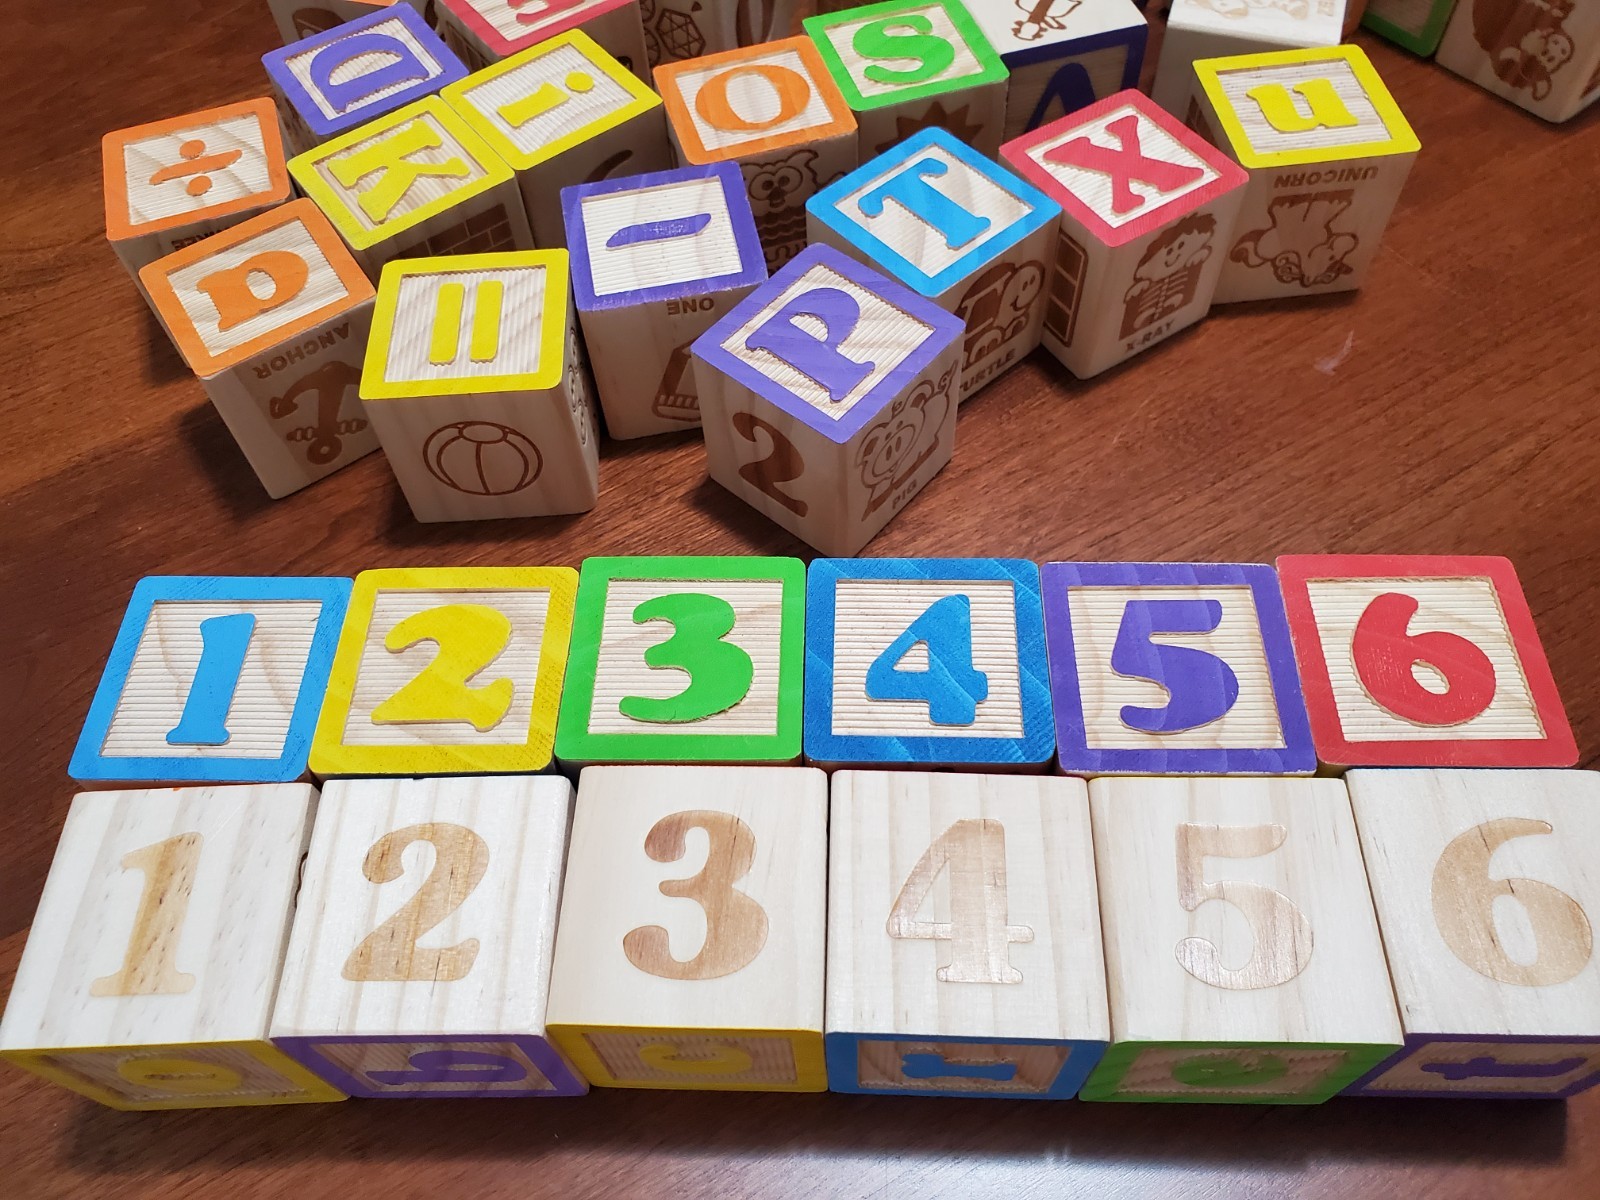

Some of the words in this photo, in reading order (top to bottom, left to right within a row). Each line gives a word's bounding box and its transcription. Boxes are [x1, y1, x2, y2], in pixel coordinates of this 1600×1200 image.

[310, 34, 429, 113] D
[852, 14, 955, 83] S
[327, 119, 468, 222] K
[858, 158, 991, 249] T
[1043, 115, 1204, 214] X
[1273, 166, 1378, 188] UNICORN
[252, 322, 348, 379] ANCHOR
[667, 298, 714, 315] ONE
[745, 287, 875, 403] P
[732, 412, 808, 518] 2
[892, 479, 917, 509] PIG
[167, 613, 257, 745] 1
[371, 604, 513, 731] 2
[619, 592, 753, 723] 3
[866, 594, 988, 726] 4
[1111, 600, 1239, 734] 5
[1351, 592, 1496, 728] 6
[89, 832, 203, 998] 1
[341, 822, 490, 981] 2
[623, 810, 769, 980] 3
[886, 819, 1034, 984] 4
[1176, 823, 1314, 990] 5
[1431, 817, 1593, 986] 6
